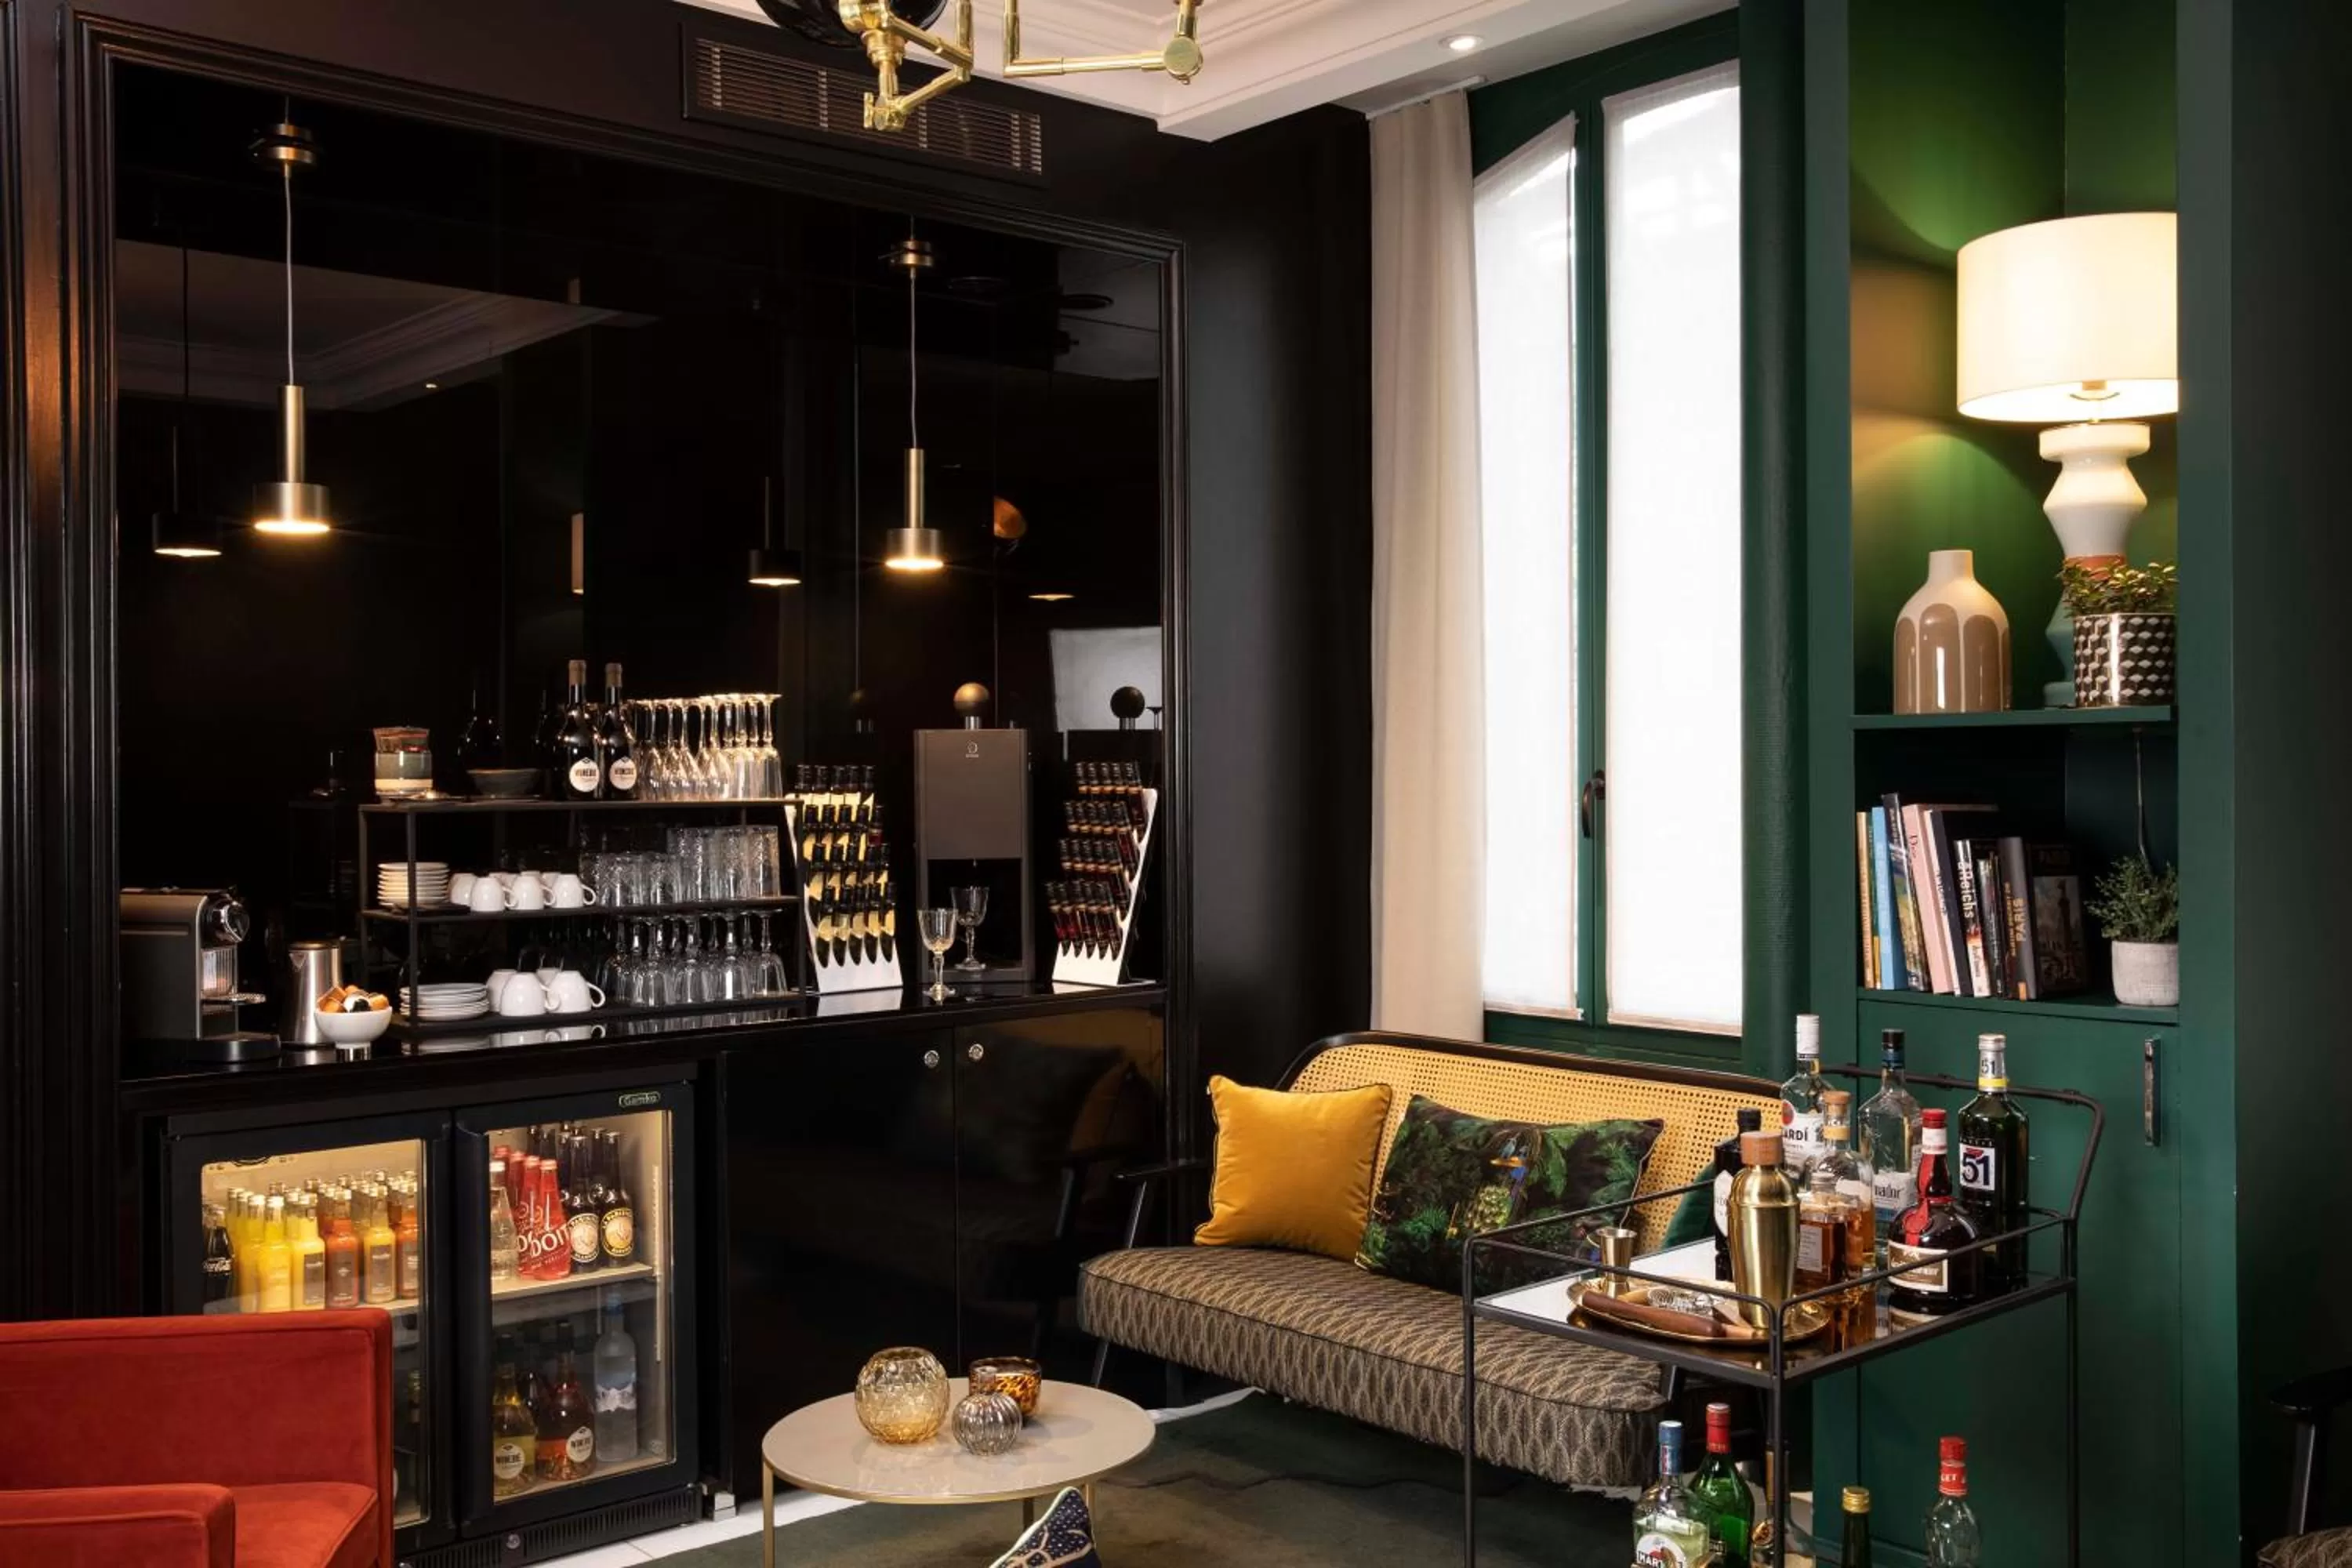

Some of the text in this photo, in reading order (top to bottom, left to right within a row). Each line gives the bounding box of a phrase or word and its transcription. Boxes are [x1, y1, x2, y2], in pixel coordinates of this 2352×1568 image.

[2013, 898, 2027, 941] PARIS
[1981, 1059, 1995, 1075] 51
[1783, 1126, 1808, 1142] ARDÍ
[1962, 1152, 1990, 1185] 51
